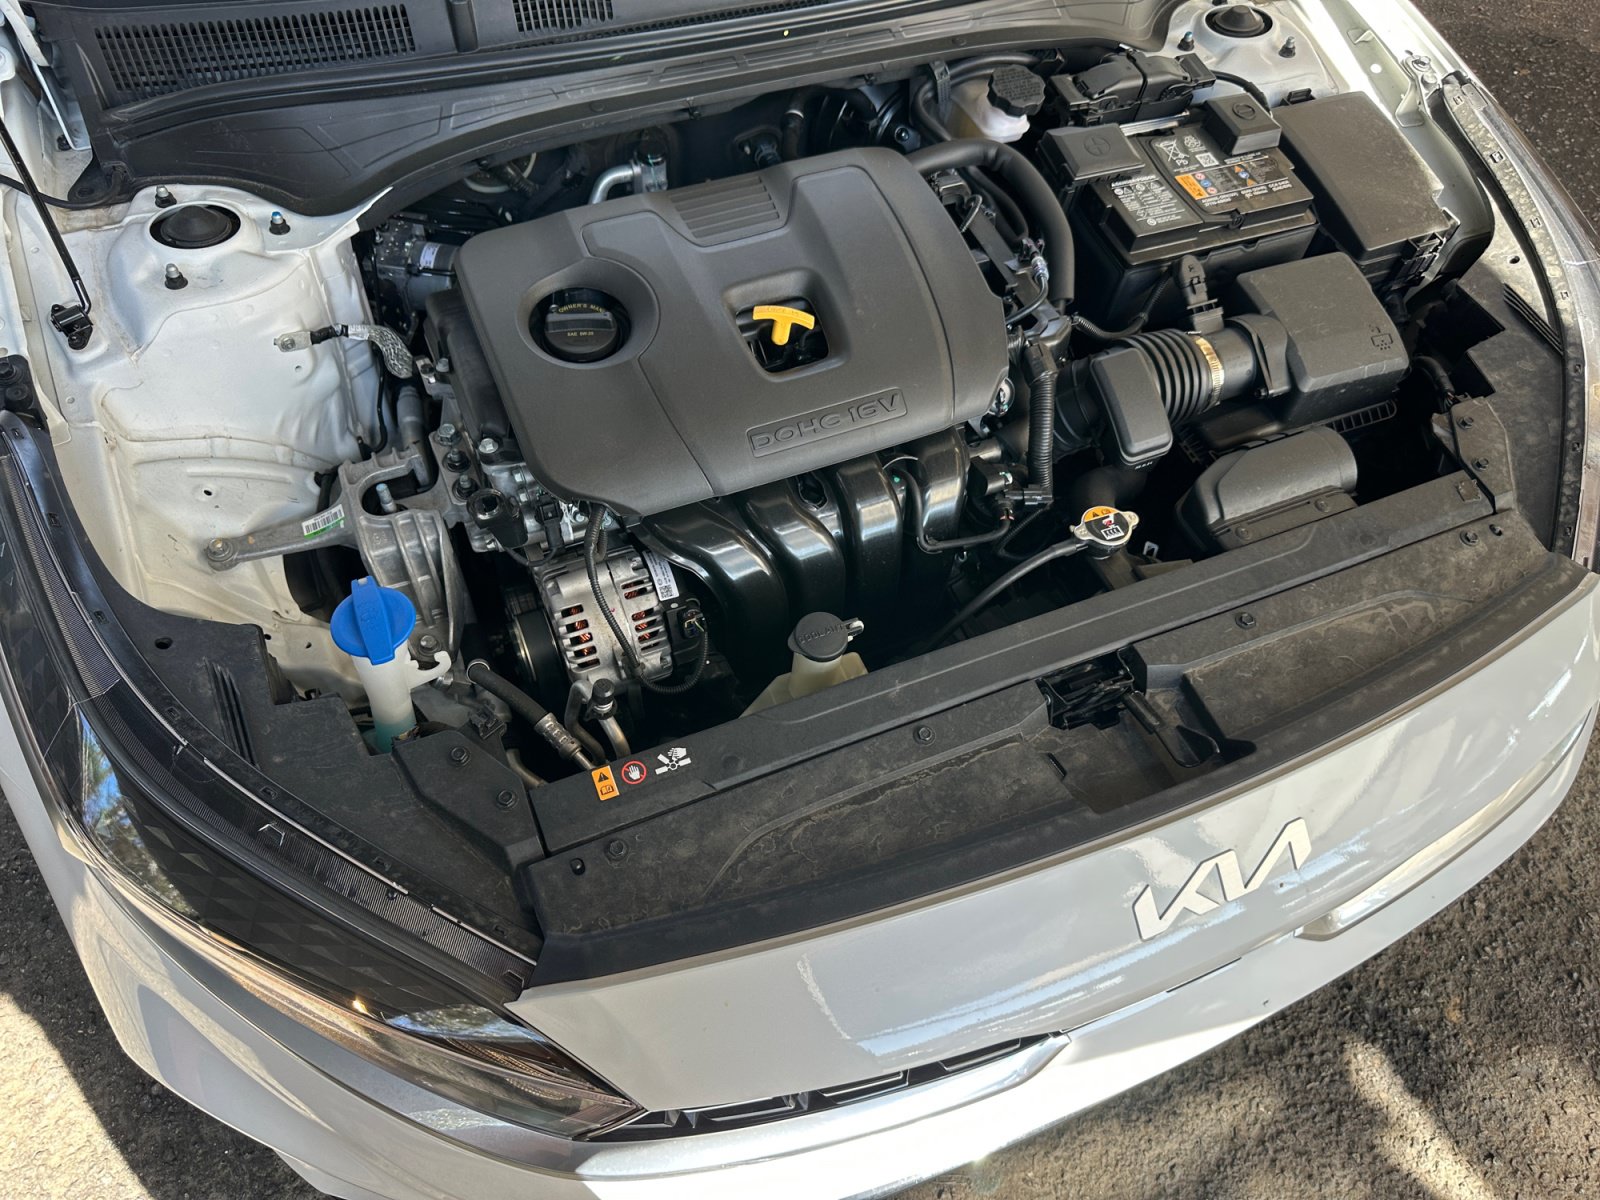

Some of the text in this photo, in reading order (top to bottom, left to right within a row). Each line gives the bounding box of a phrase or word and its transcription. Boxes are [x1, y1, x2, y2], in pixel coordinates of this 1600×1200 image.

[1175, 158, 1189, 166] Pb
[559, 304, 605, 313] OWNER'S MAN
[750, 393, 900, 451] DOHC 16V
[798, 623, 844, 644] COOLANT
[1132, 816, 1312, 942] KIA
